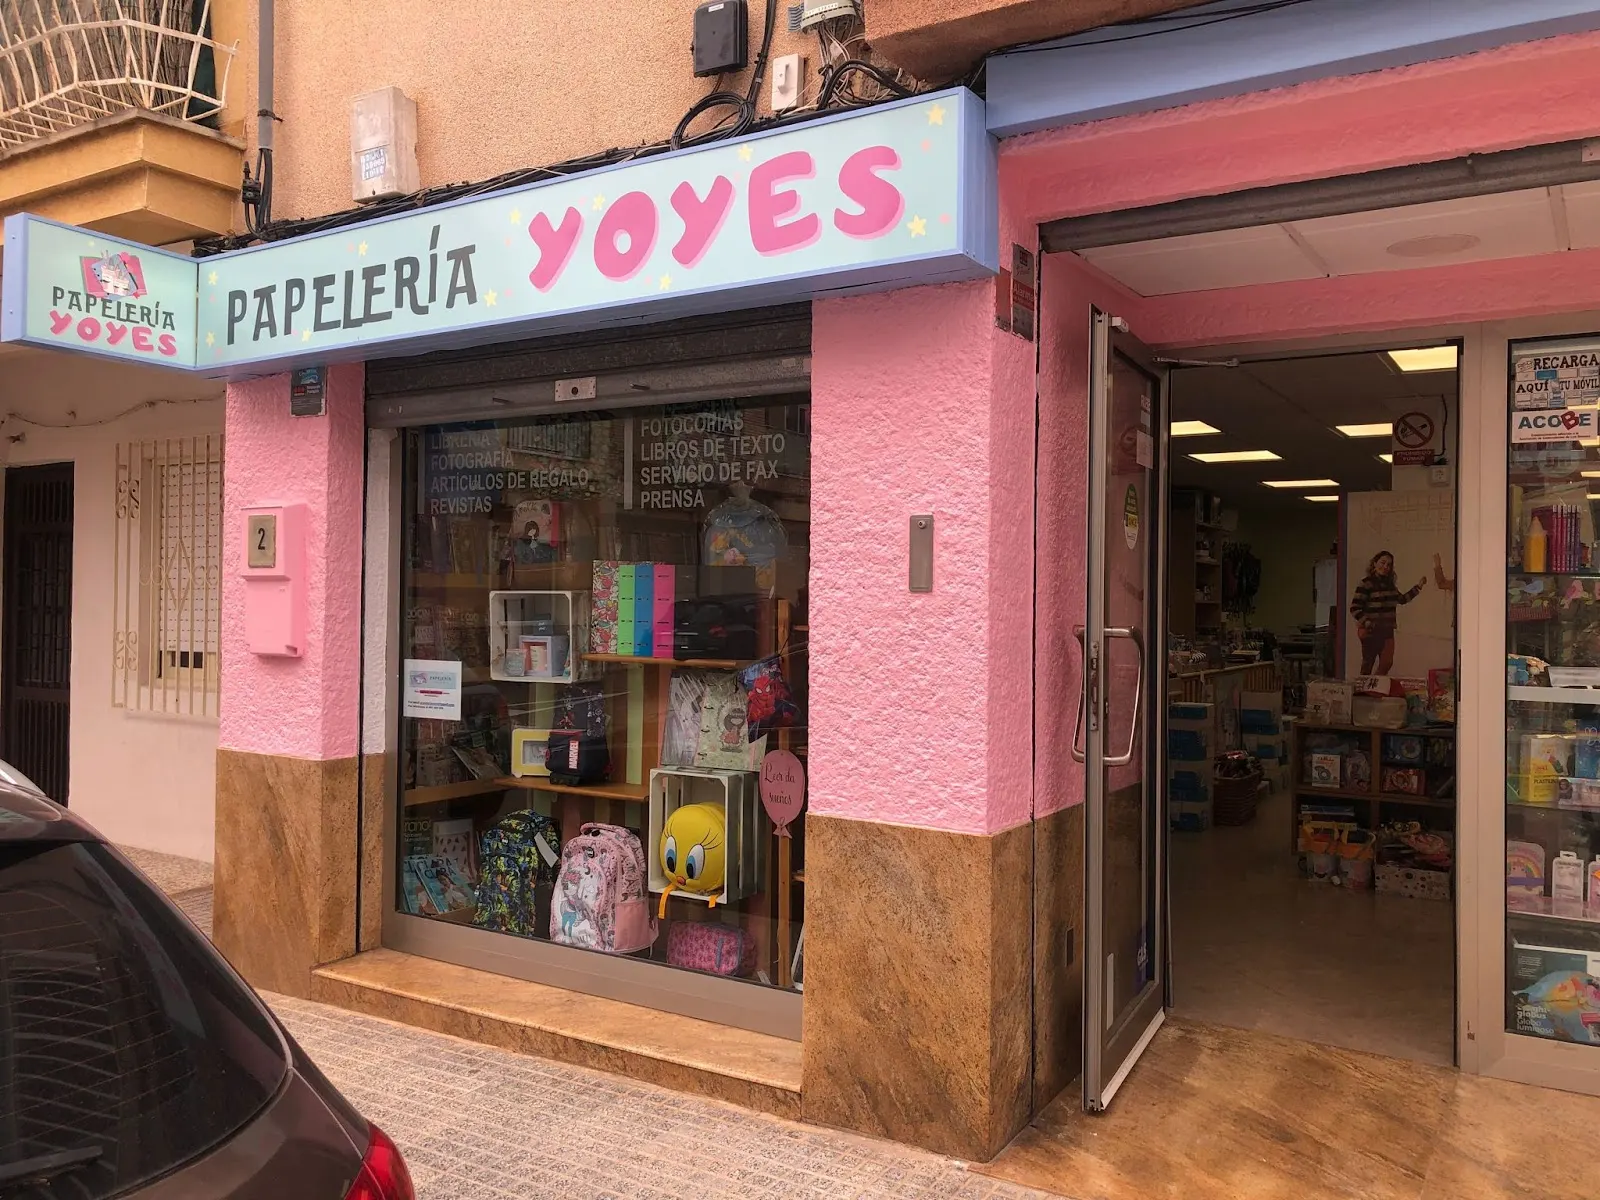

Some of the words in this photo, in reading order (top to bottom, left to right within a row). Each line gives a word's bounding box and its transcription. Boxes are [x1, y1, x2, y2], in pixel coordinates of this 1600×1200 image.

[228, 225, 476, 345] PAPELERÍA
[528, 145, 906, 293] YOYES
[53, 280, 176, 331] PAPELERÍA
[49, 310, 178, 357] YOYES
[1533, 353, 1600, 370] RECARGA
[1516, 379, 1549, 394] AQUÍ
[641, 412, 744, 437] FOTOCOPIAS
[1518, 411, 1592, 431] ACOBE
[641, 440, 699, 462] LIBROS
[703, 437, 725, 459] DE
[729, 433, 785, 456] TEXTO
[507, 471, 526, 490] DE
[529, 468, 589, 488] REGALO
[640, 463, 714, 486] SERVICIO
[719, 462, 741, 482] DE
[747, 459, 779, 481] FAX
[430, 496, 492, 515] REVISTAS
[640, 489, 706, 509] PRENSA
[257, 527, 266, 551] 2
[568, 740, 580, 769] MARVEL
[764, 762, 783, 783] Leer
[785, 766, 796, 783] da
[769, 790, 792, 805] sueños
